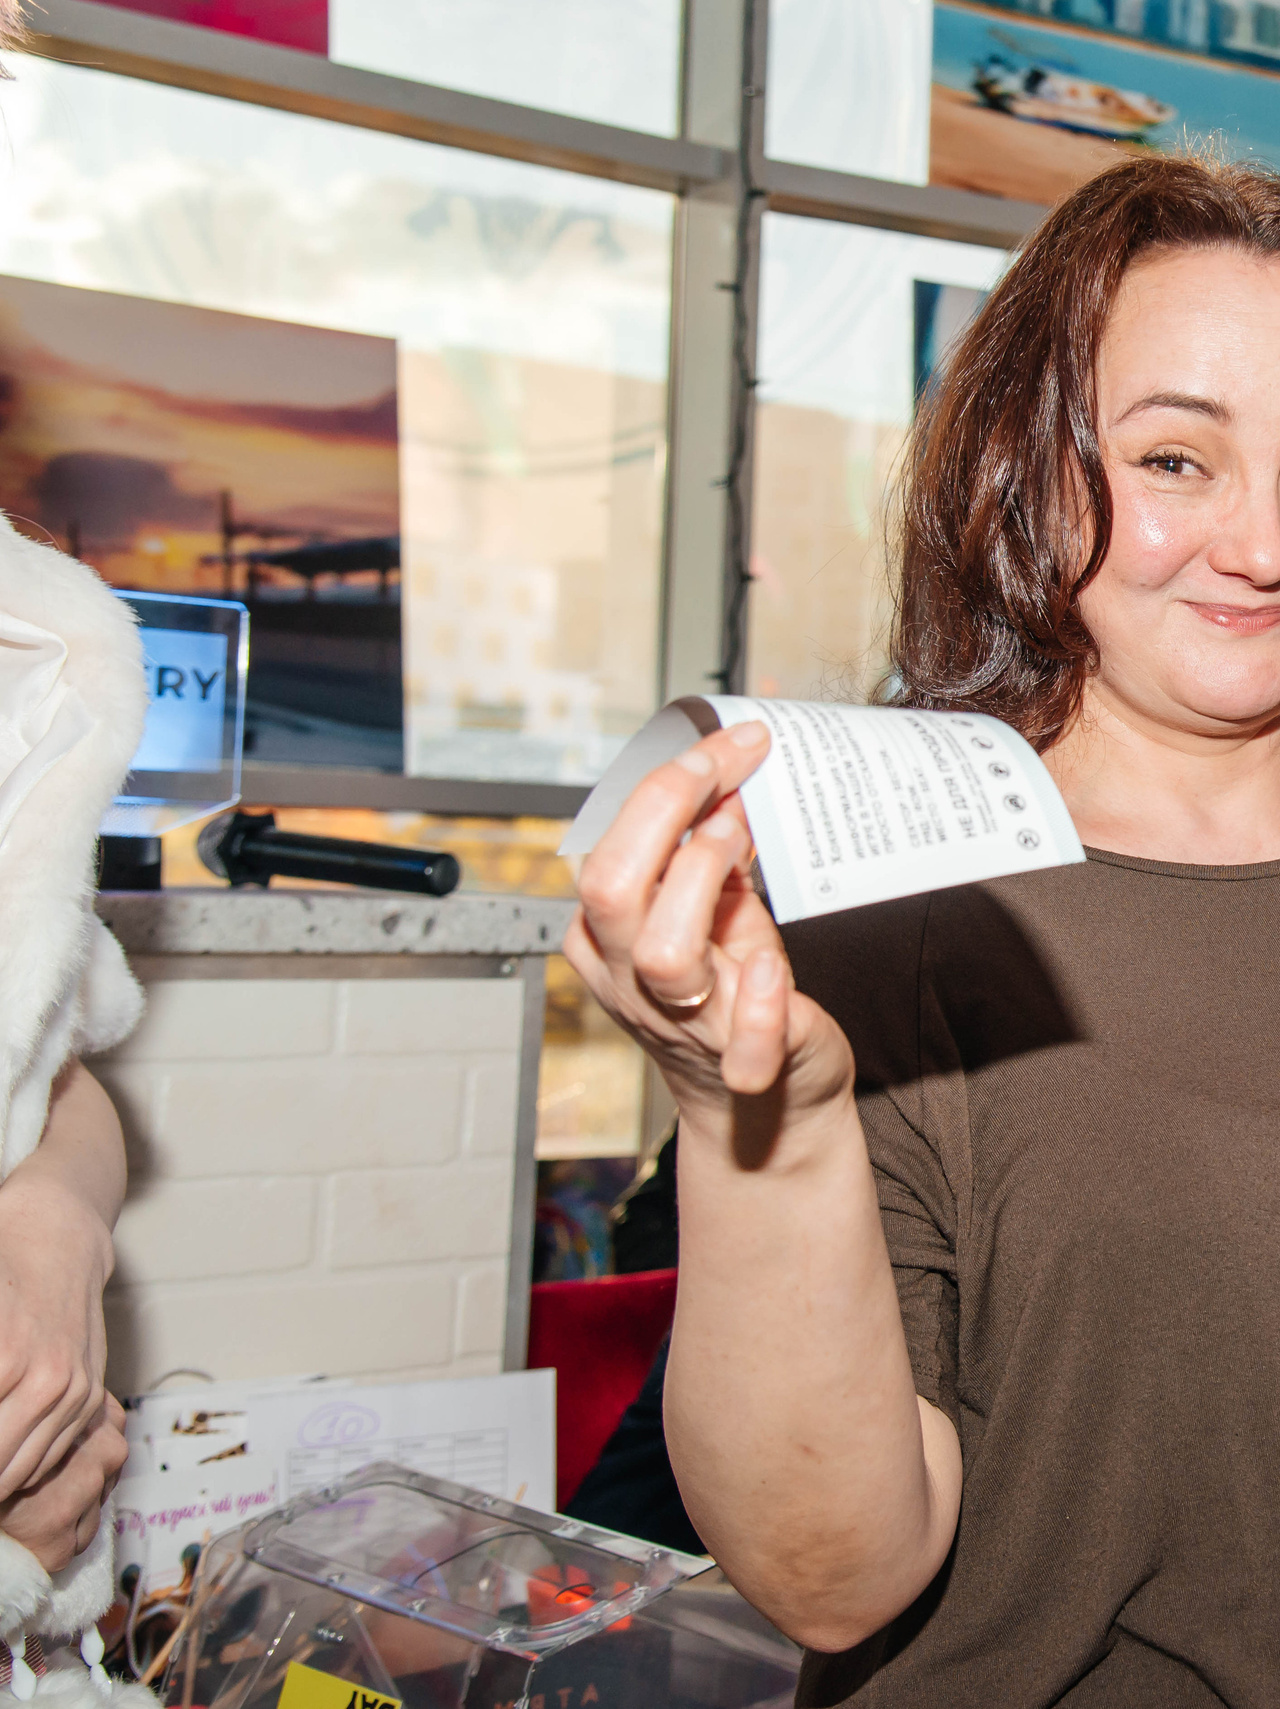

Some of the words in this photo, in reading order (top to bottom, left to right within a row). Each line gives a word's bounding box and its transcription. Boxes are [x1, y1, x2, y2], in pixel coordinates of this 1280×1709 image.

[145, 665, 218, 700] RY
[944, 777, 970, 810] ДЛЯ
[957, 815, 977, 838] НЕ
